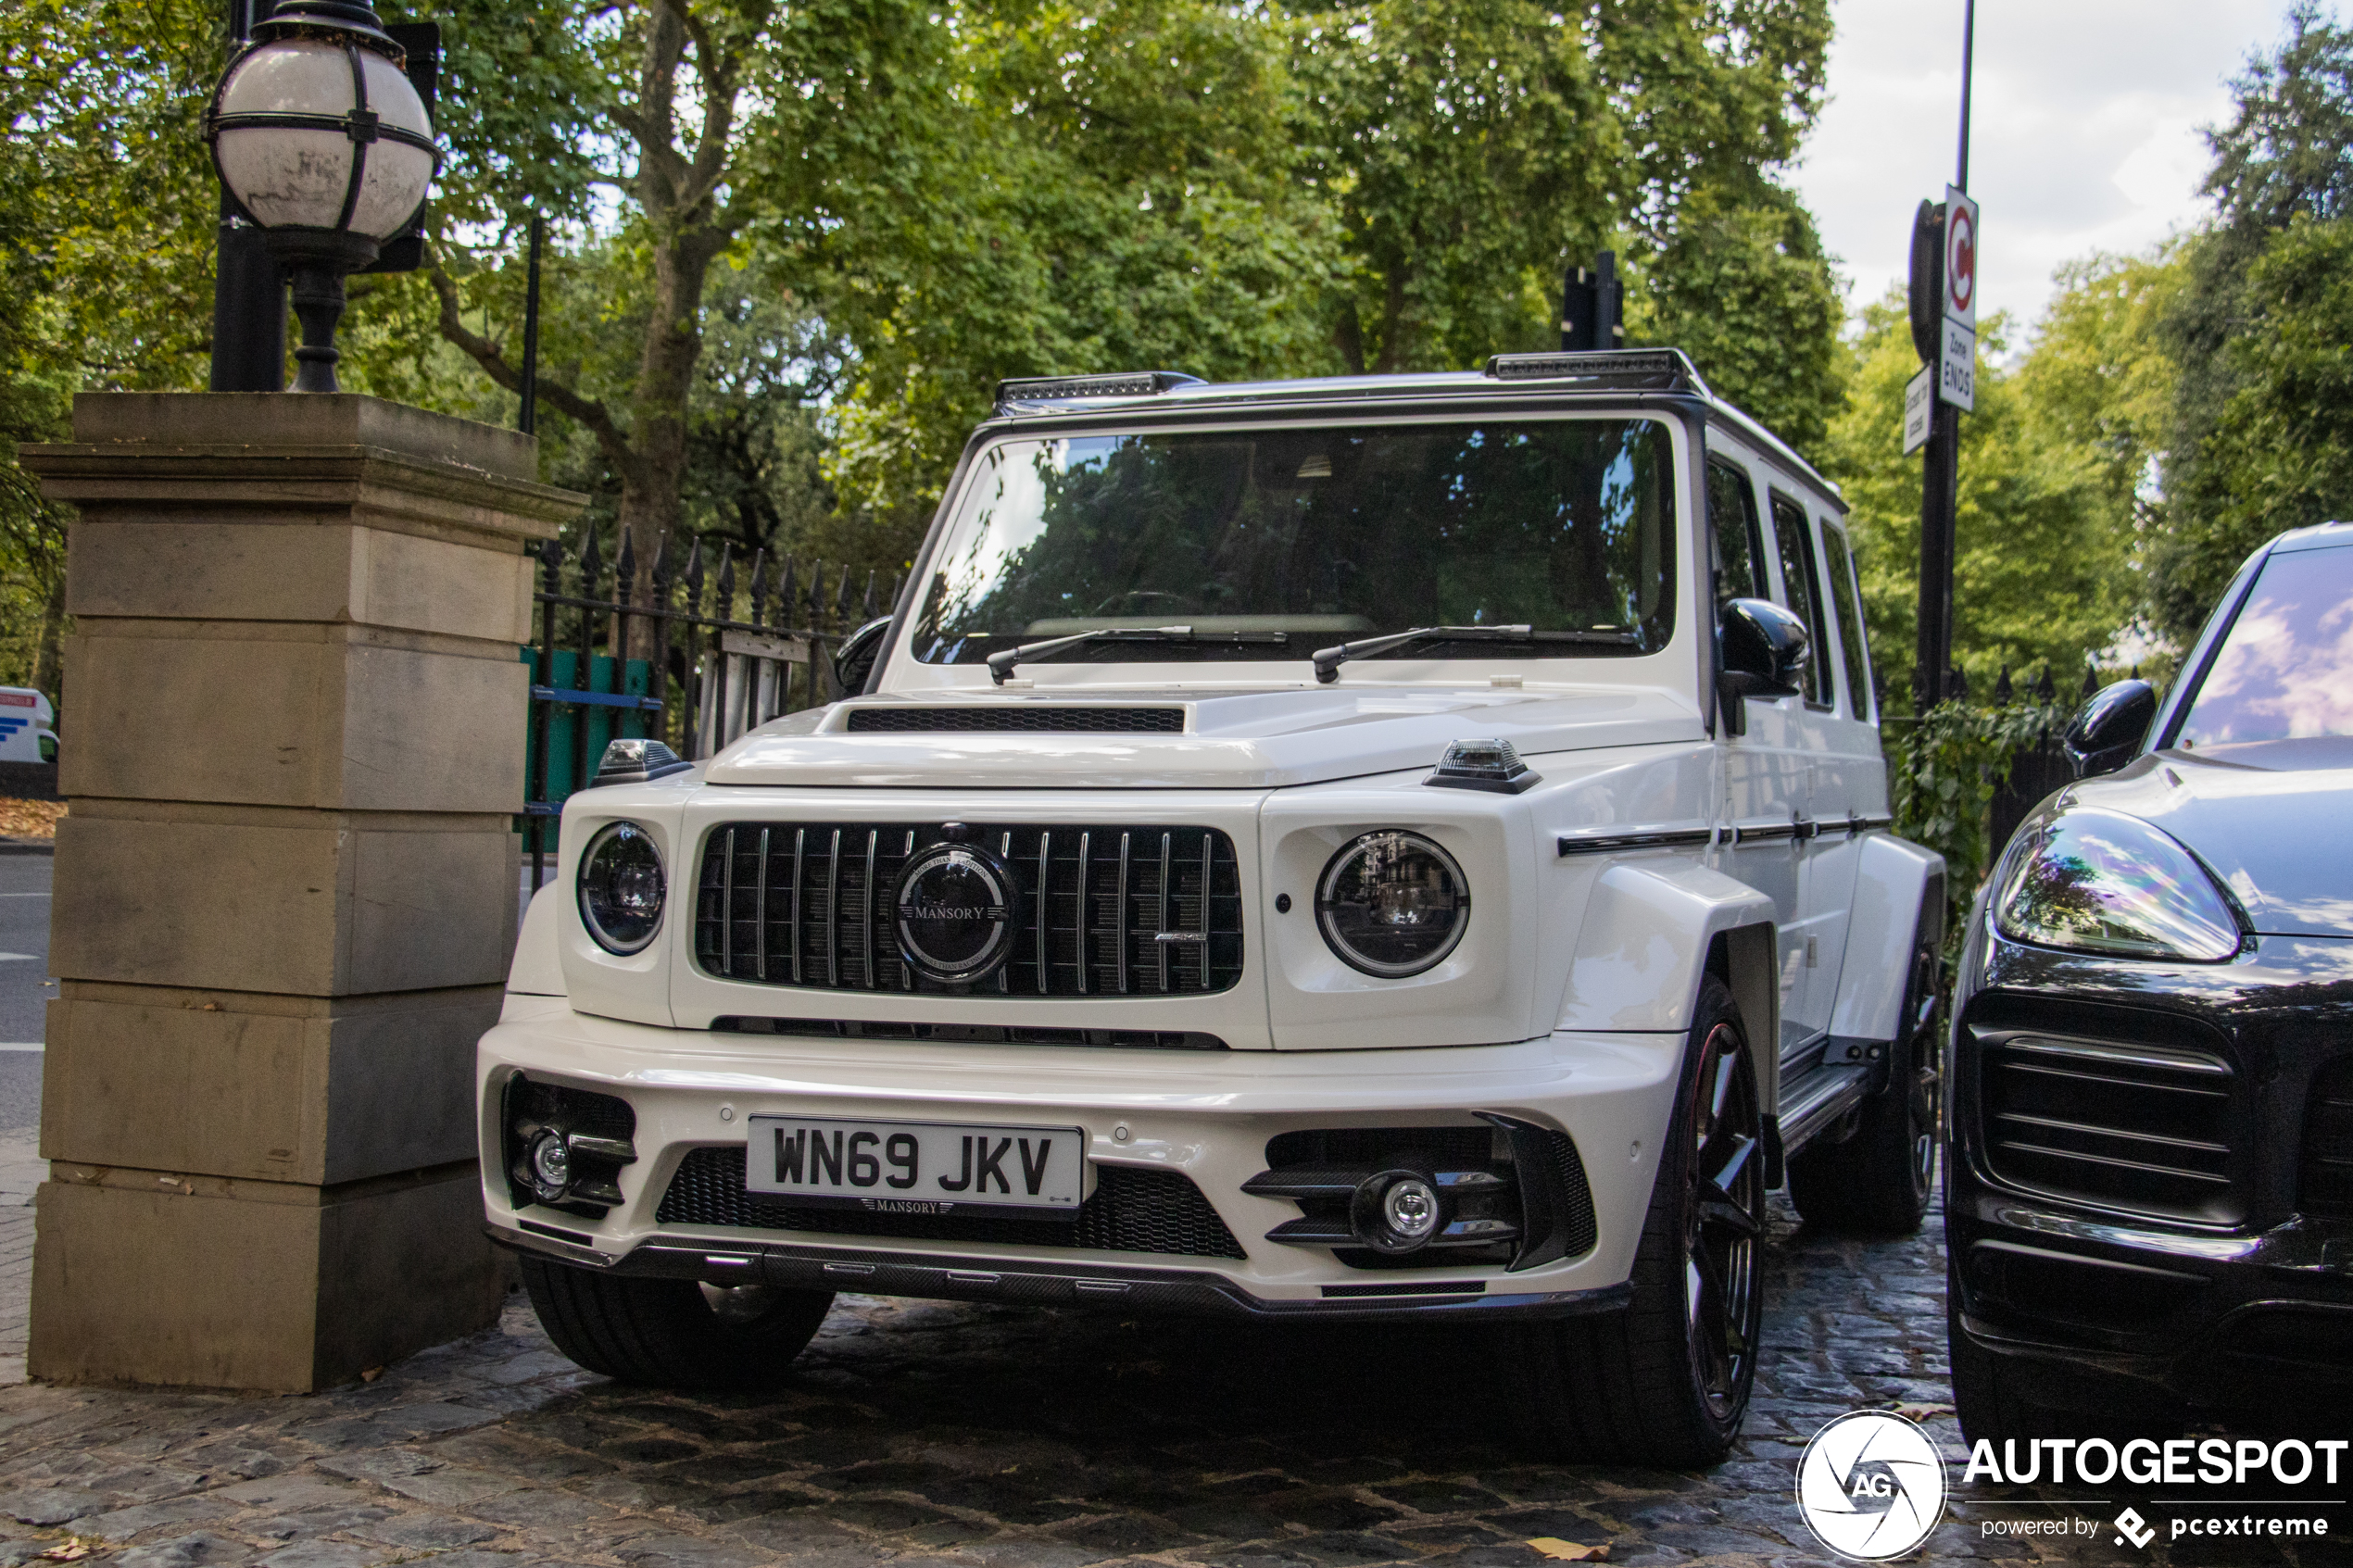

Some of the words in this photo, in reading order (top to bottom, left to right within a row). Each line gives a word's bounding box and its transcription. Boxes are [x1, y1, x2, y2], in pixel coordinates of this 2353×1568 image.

[1950, 332, 1967, 359] Zone
[1944, 360, 1970, 396] ENDS
[914, 861, 932, 878] MORE
[932, 857, 951, 866] THAN
[915, 907, 984, 920] MANSORY
[774, 1127, 920, 1190] WN69
[937, 1135, 1052, 1196] JKV
[877, 1199, 937, 1214] MANSORY
